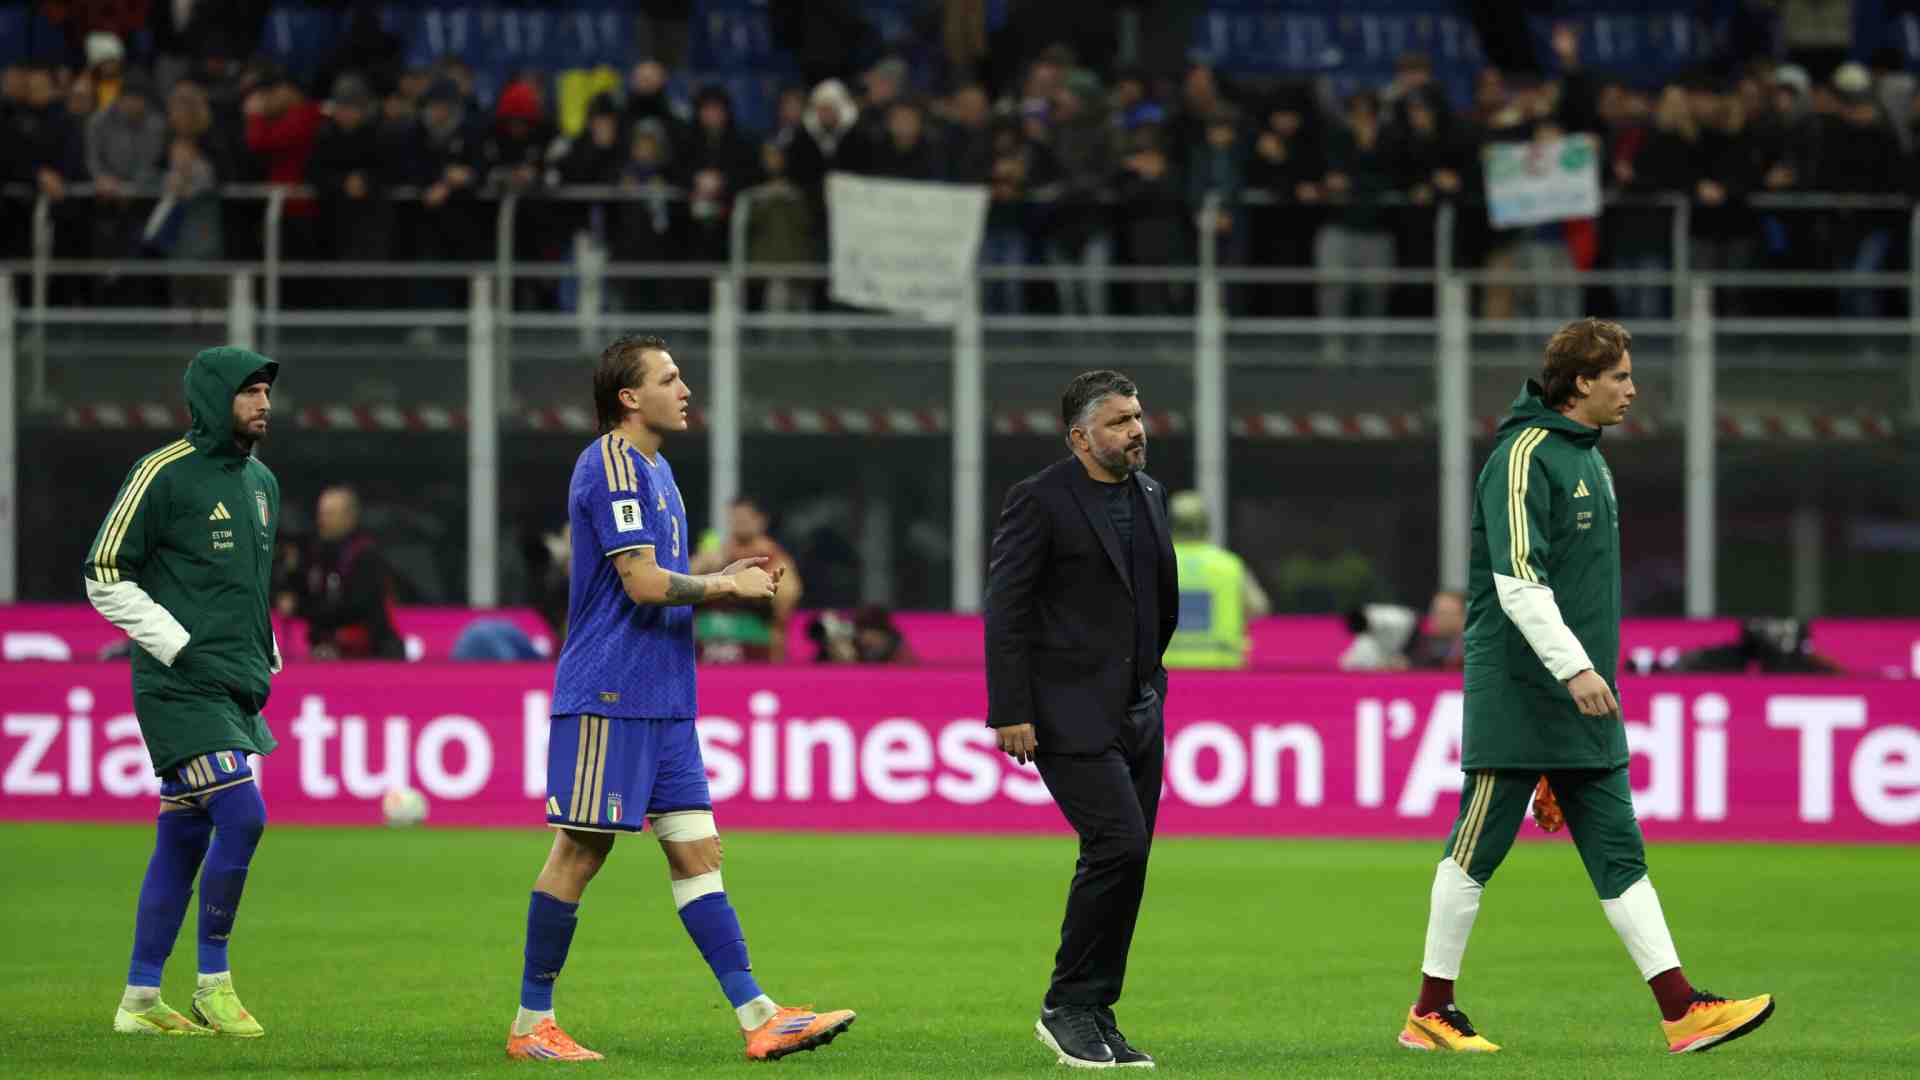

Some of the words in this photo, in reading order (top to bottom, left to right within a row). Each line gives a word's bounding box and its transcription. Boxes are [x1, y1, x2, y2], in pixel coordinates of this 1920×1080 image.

[671, 514, 680, 557] 3
[291, 695, 494, 799] tuo
[523, 690, 1055, 805] sines
[1161, 720, 1324, 807] on
[1624, 693, 1729, 822] di
[1766, 695, 1920, 826] Te
